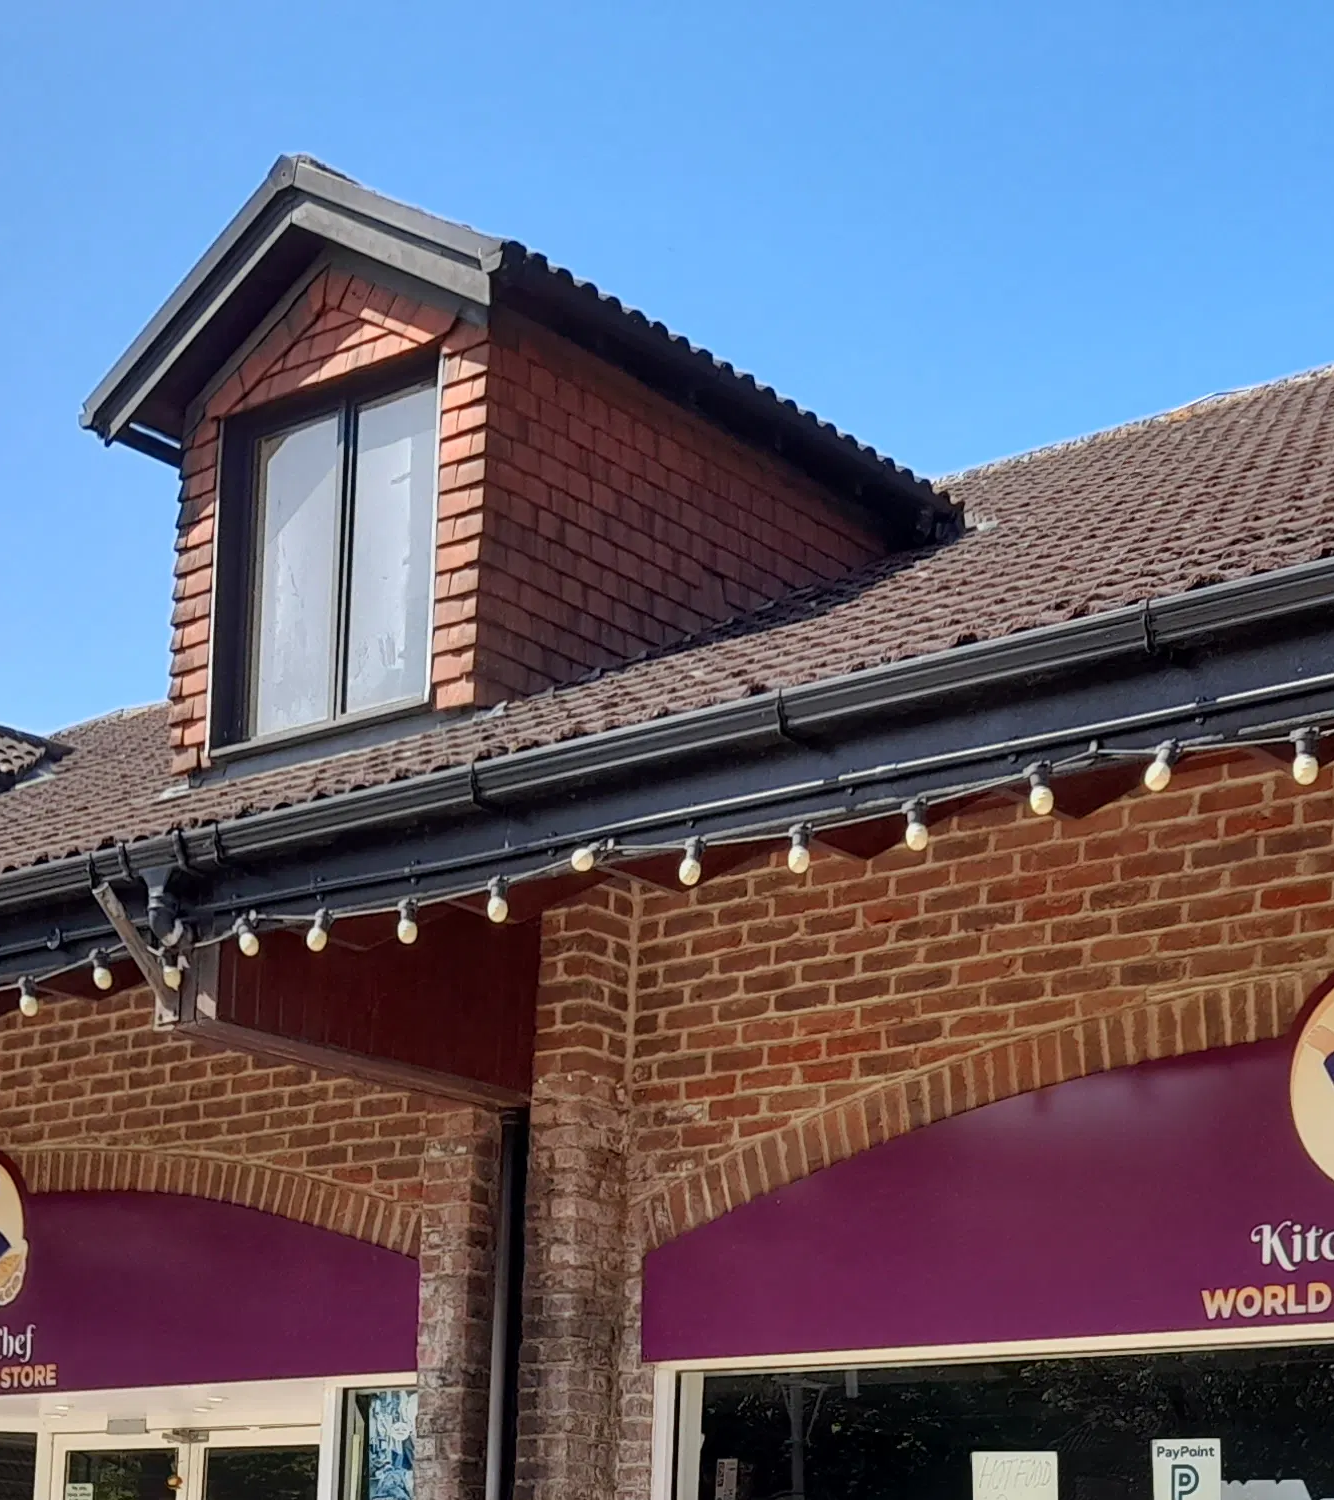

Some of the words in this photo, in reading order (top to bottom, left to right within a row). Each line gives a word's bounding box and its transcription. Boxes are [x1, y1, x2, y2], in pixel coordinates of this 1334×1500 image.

[1201, 1282, 1332, 1320] WORLD
[0, 1363, 58, 1387] STORE
[1156, 1446, 1215, 1461] PayPoint
